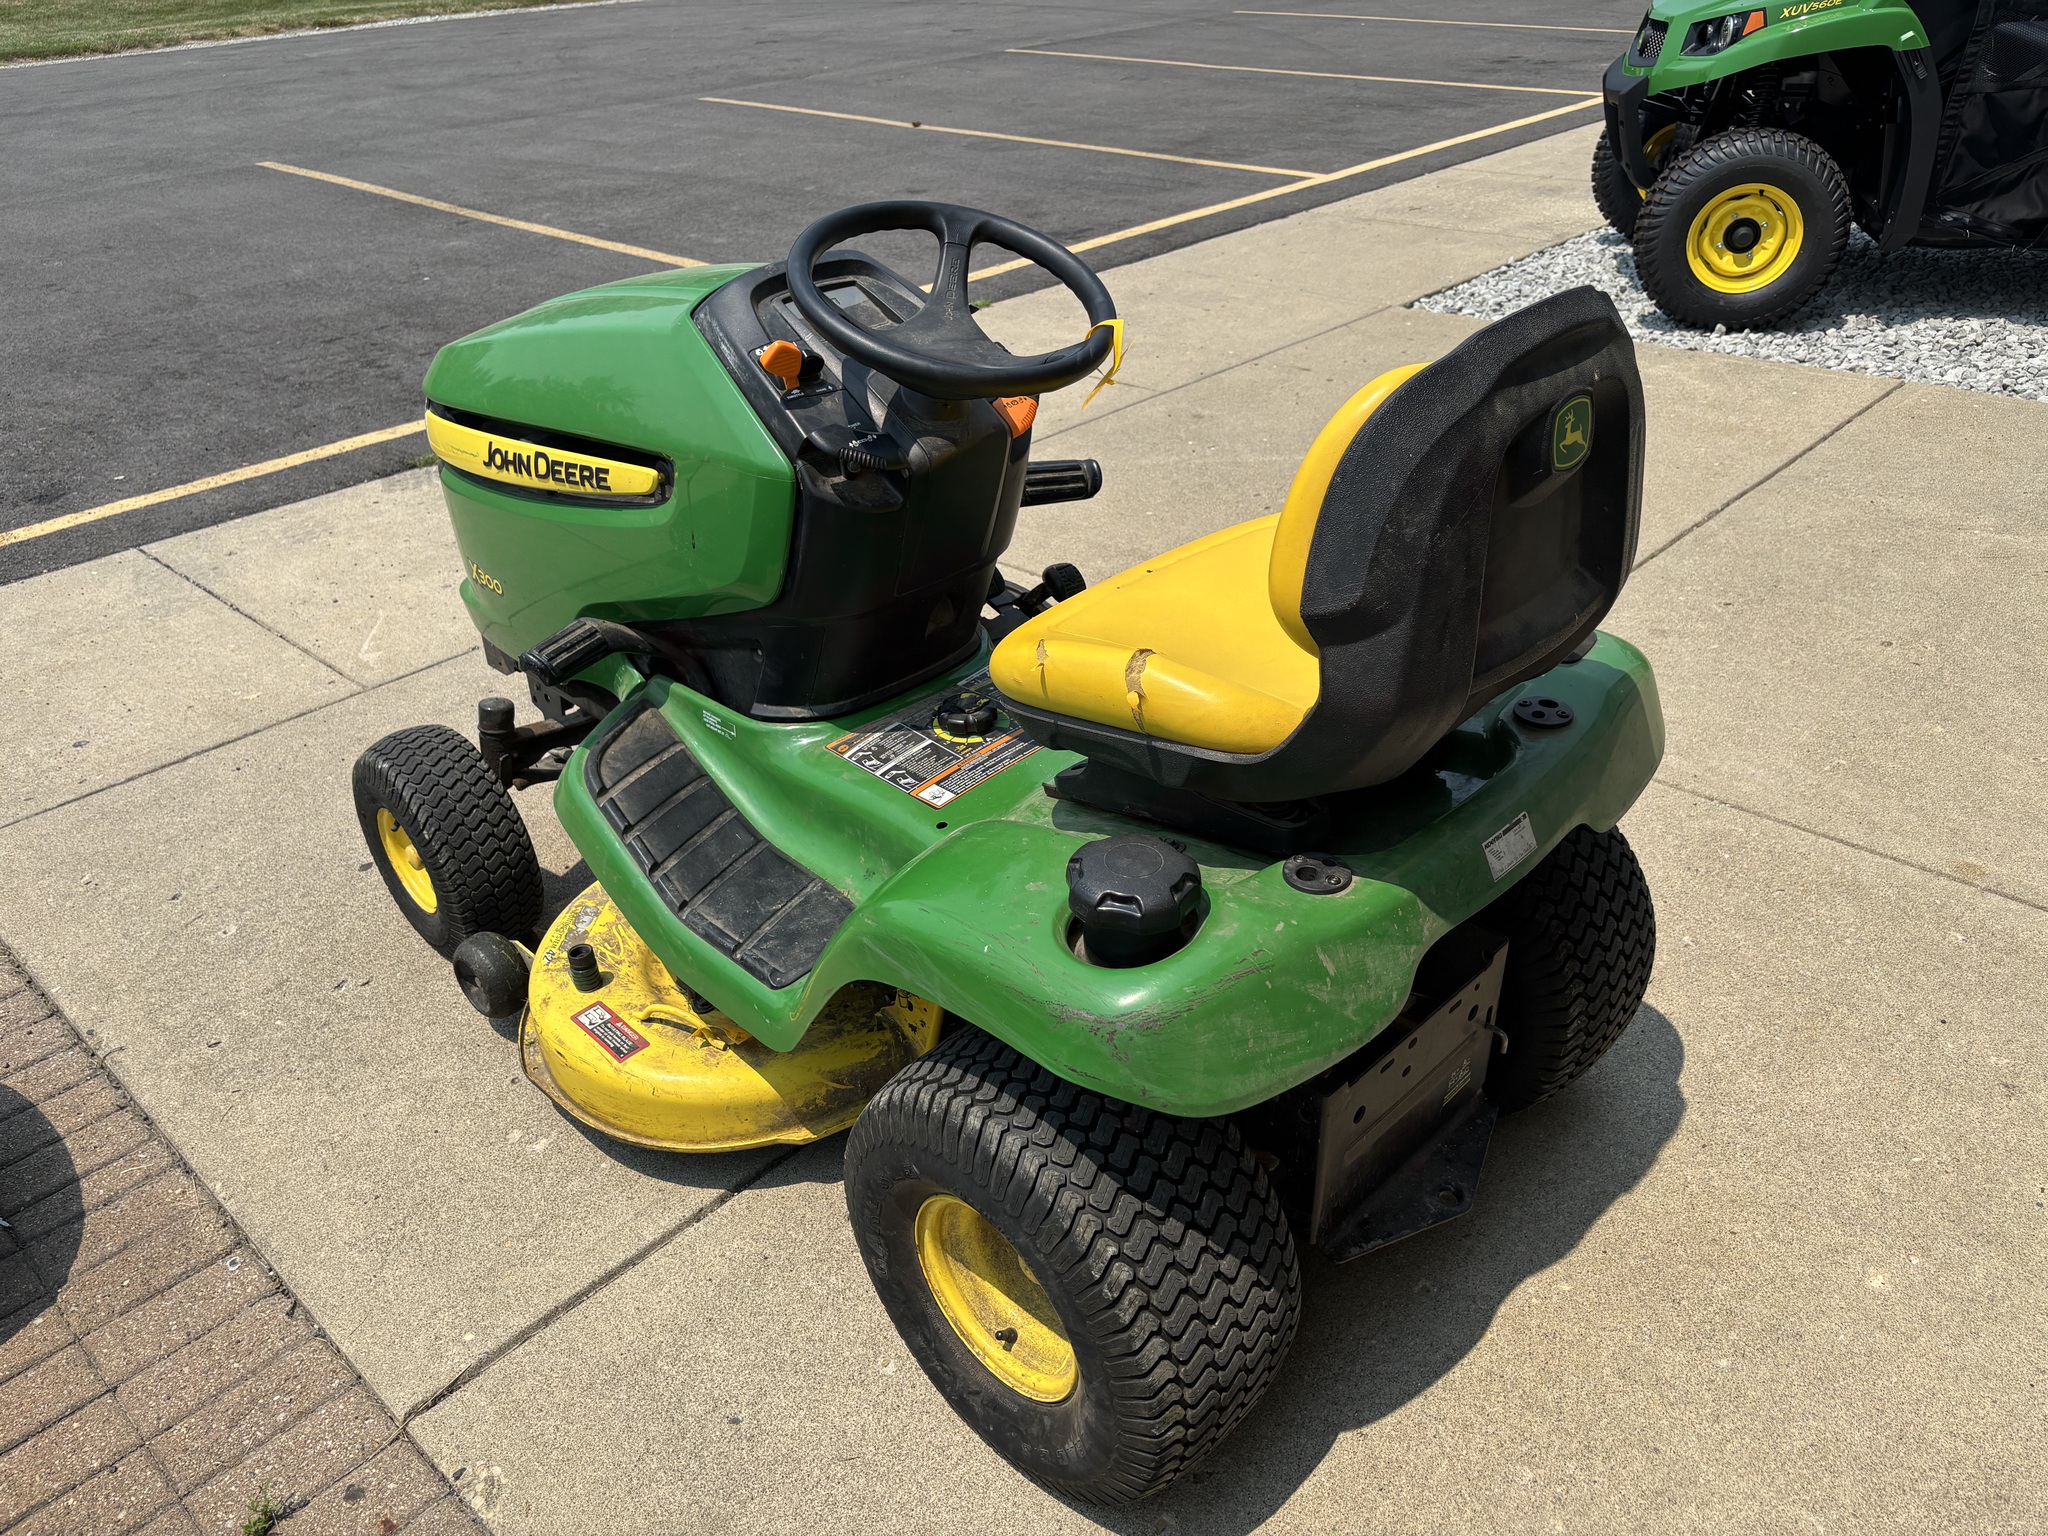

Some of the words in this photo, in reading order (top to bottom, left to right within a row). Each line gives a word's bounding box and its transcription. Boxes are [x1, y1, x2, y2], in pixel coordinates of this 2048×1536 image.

[1779, 0, 1842, 19] XUV560E
[945, 258, 960, 299] DEERE
[943, 301, 954, 320] JOHN
[482, 441, 532, 478] JOHN
[534, 451, 612, 491] DEERE
[468, 559, 503, 595] X300
[620, 1024, 639, 1040] DANGER
